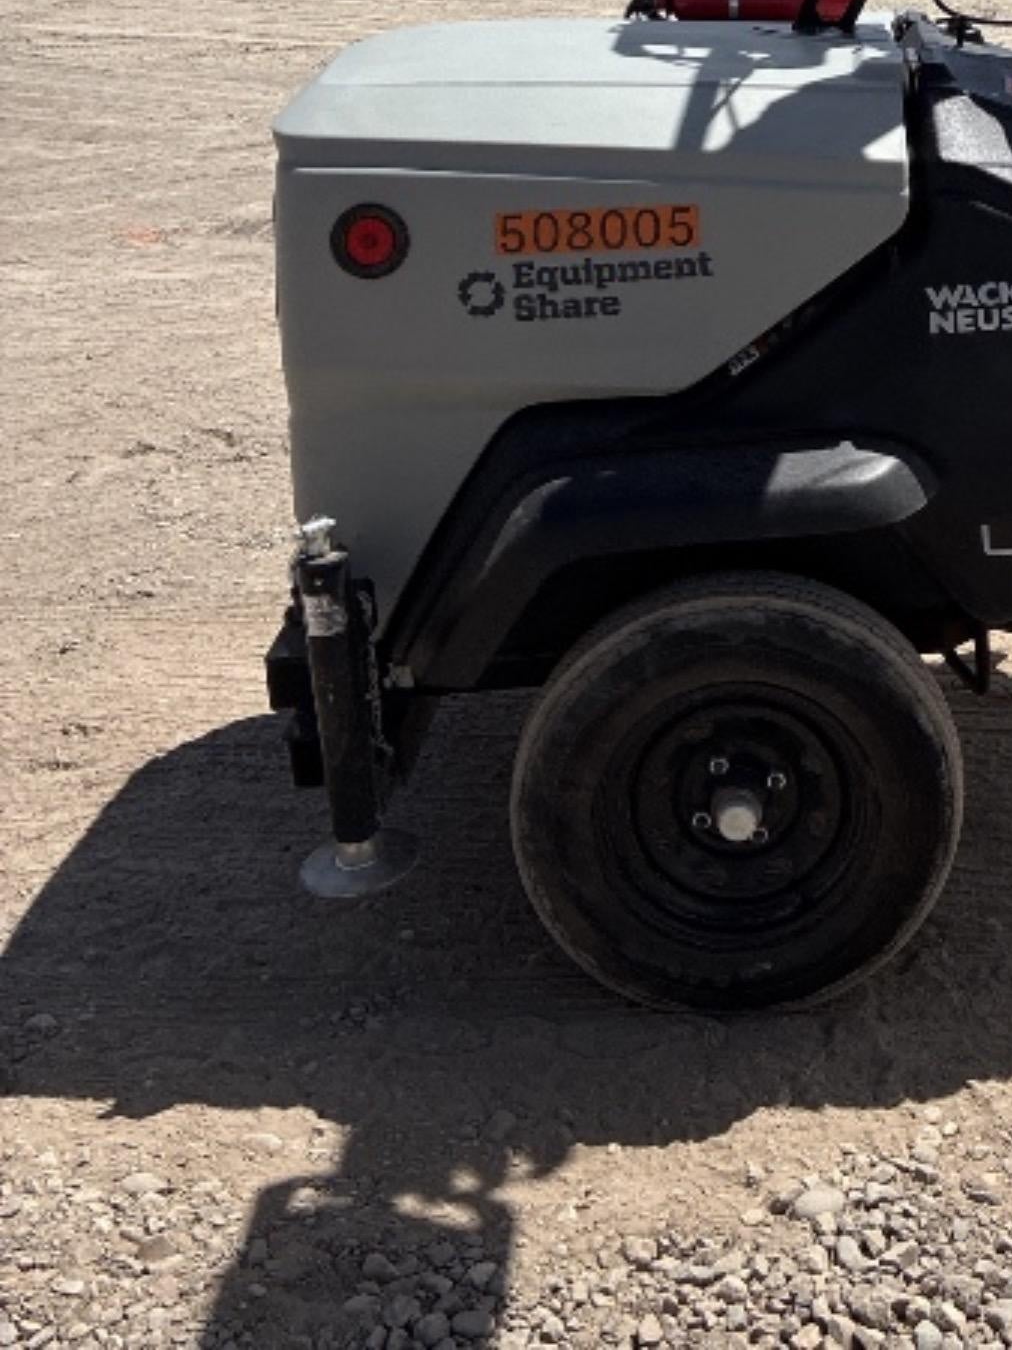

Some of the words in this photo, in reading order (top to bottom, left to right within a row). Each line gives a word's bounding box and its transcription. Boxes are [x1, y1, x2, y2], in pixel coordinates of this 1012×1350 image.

[500, 206, 695, 253] 508005
[512, 251, 714, 291] Equipment
[513, 293, 622, 322] Share
